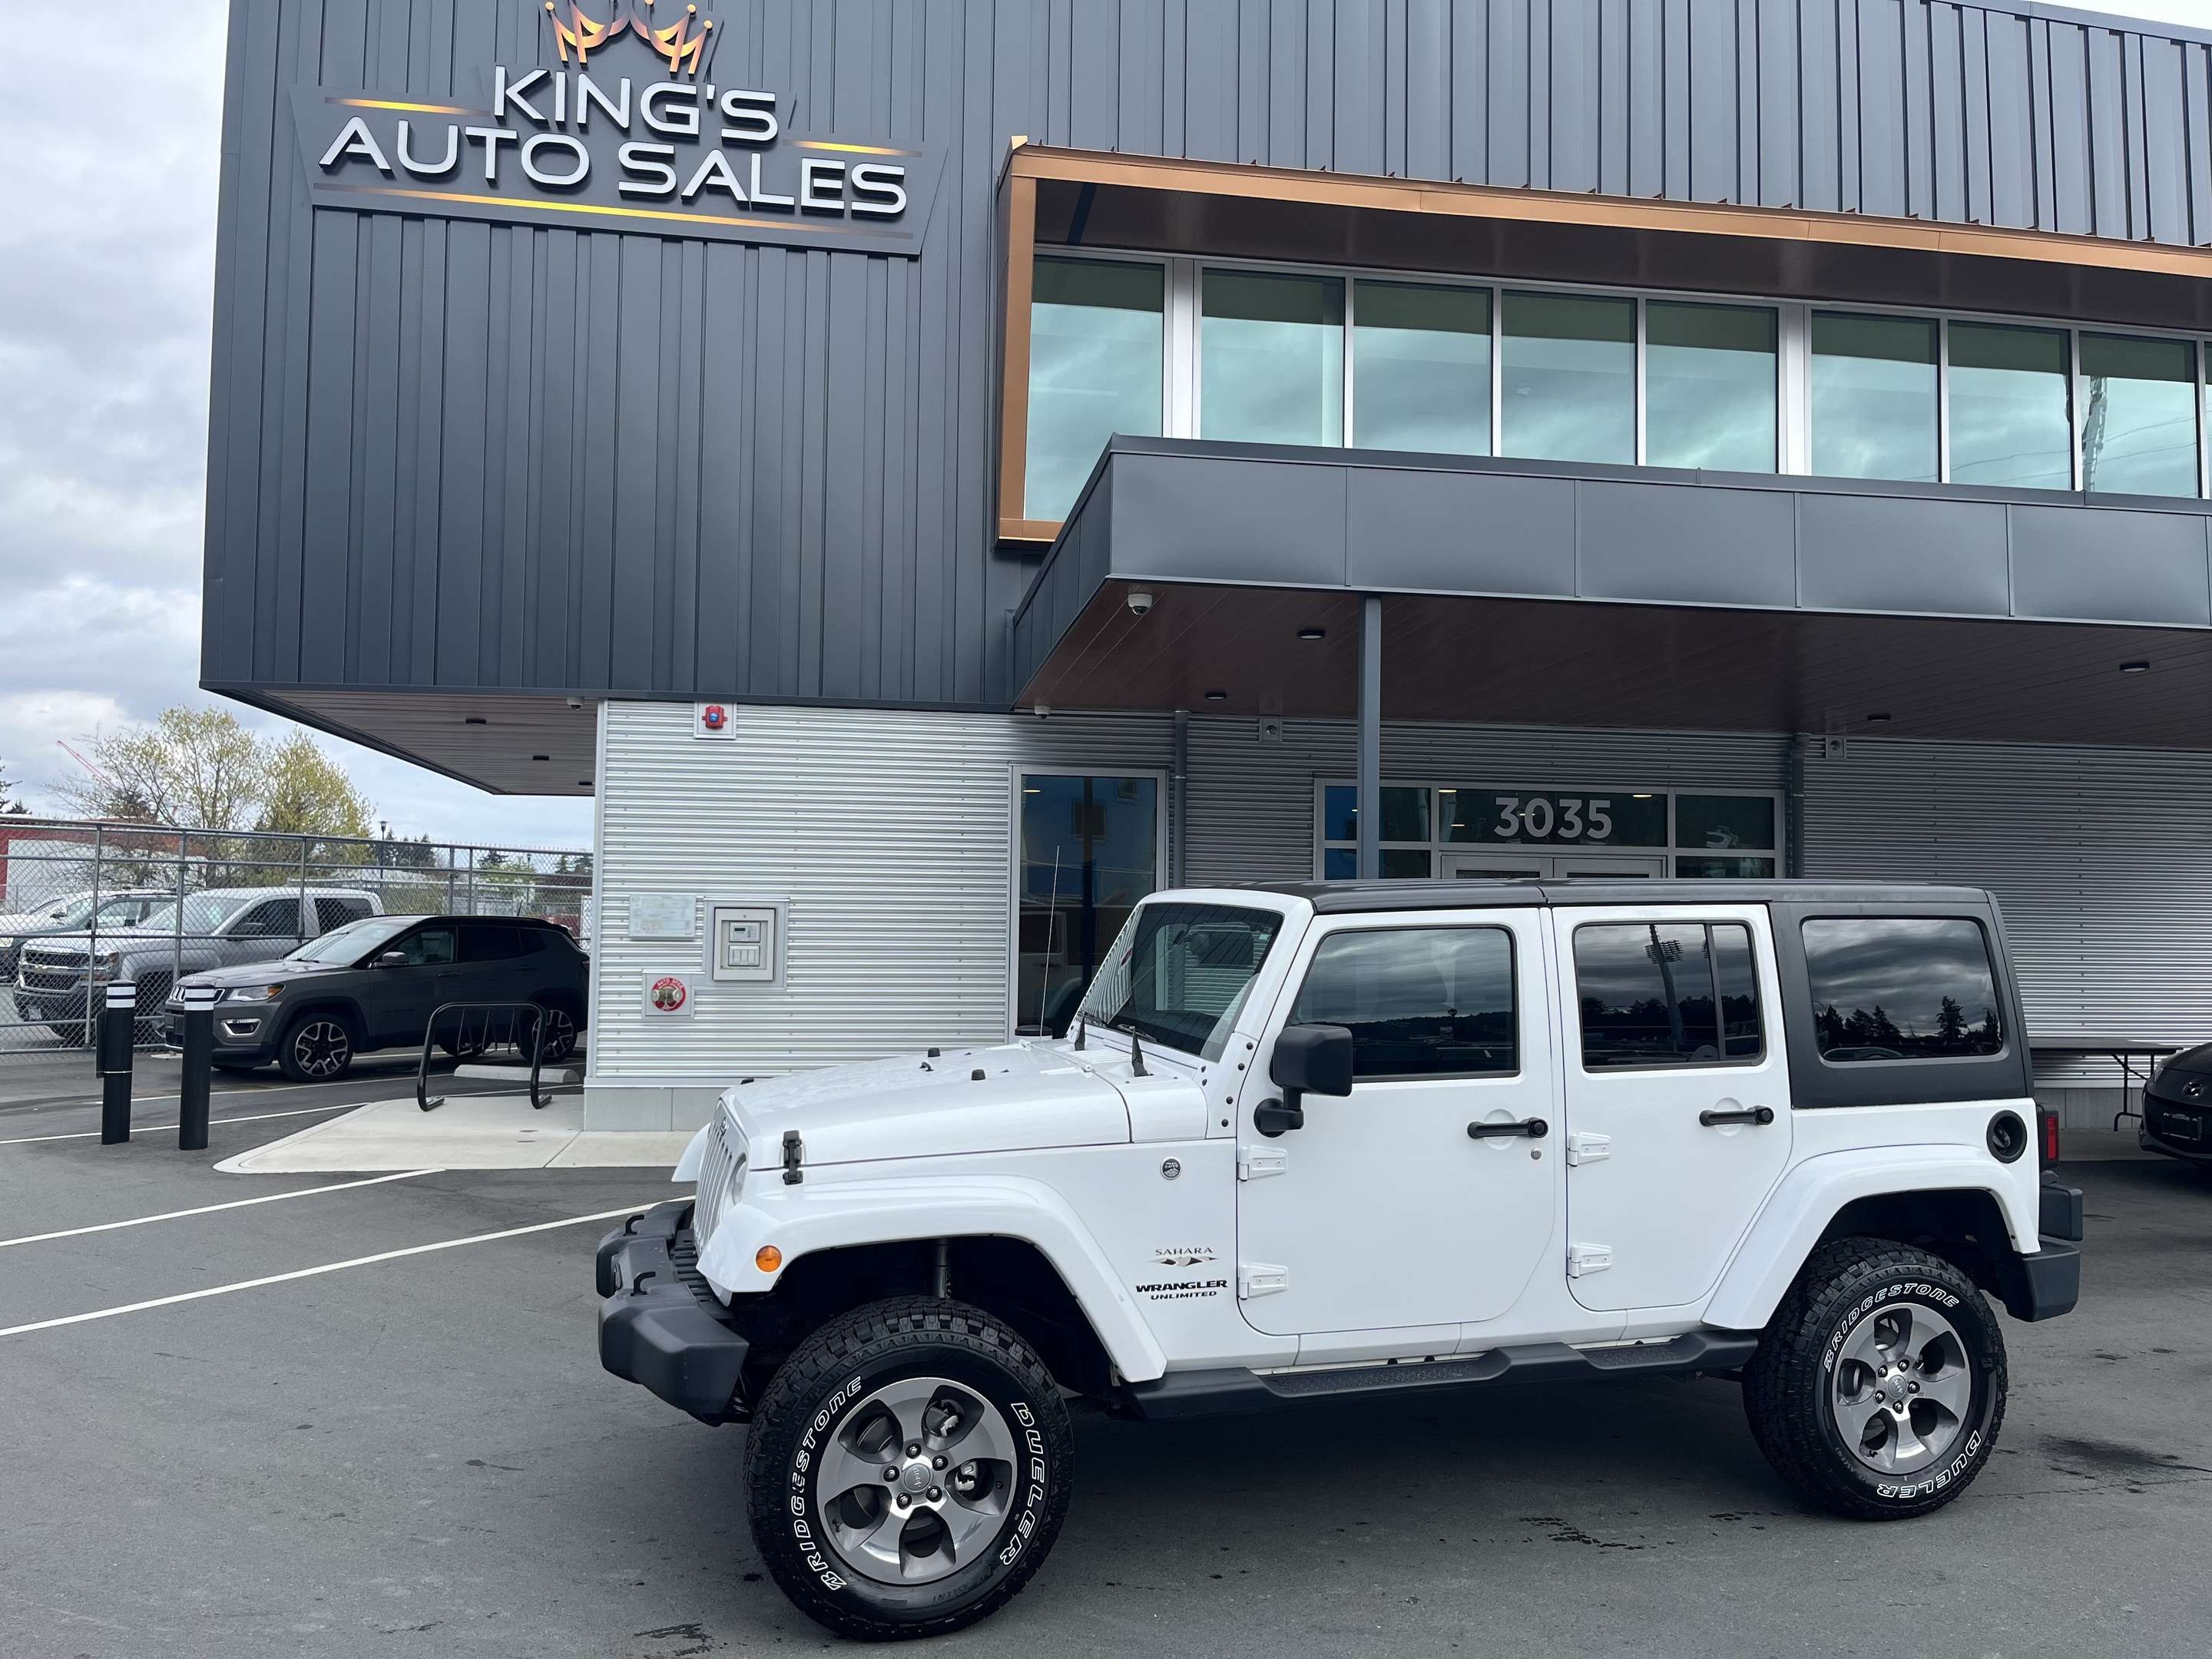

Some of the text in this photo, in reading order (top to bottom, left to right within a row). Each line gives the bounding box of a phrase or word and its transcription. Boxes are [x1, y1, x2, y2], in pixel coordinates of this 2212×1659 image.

[493, 65, 779, 142] KING'S
[319, 115, 909, 217] AUTO SALES
[1493, 797, 1612, 839] 3035
[1136, 1280, 1228, 1293] WRANGLER
[1155, 1247, 1213, 1255] SAHARA
[1151, 1290, 1217, 1300] UNLIMITED
[1823, 1283, 1960, 1373] BRIDGESTONE
[790, 1376, 863, 1591] BRIDGESTONE
[999, 1402, 1045, 1566] DUELER
[1876, 1430, 1982, 1498] DUELER
